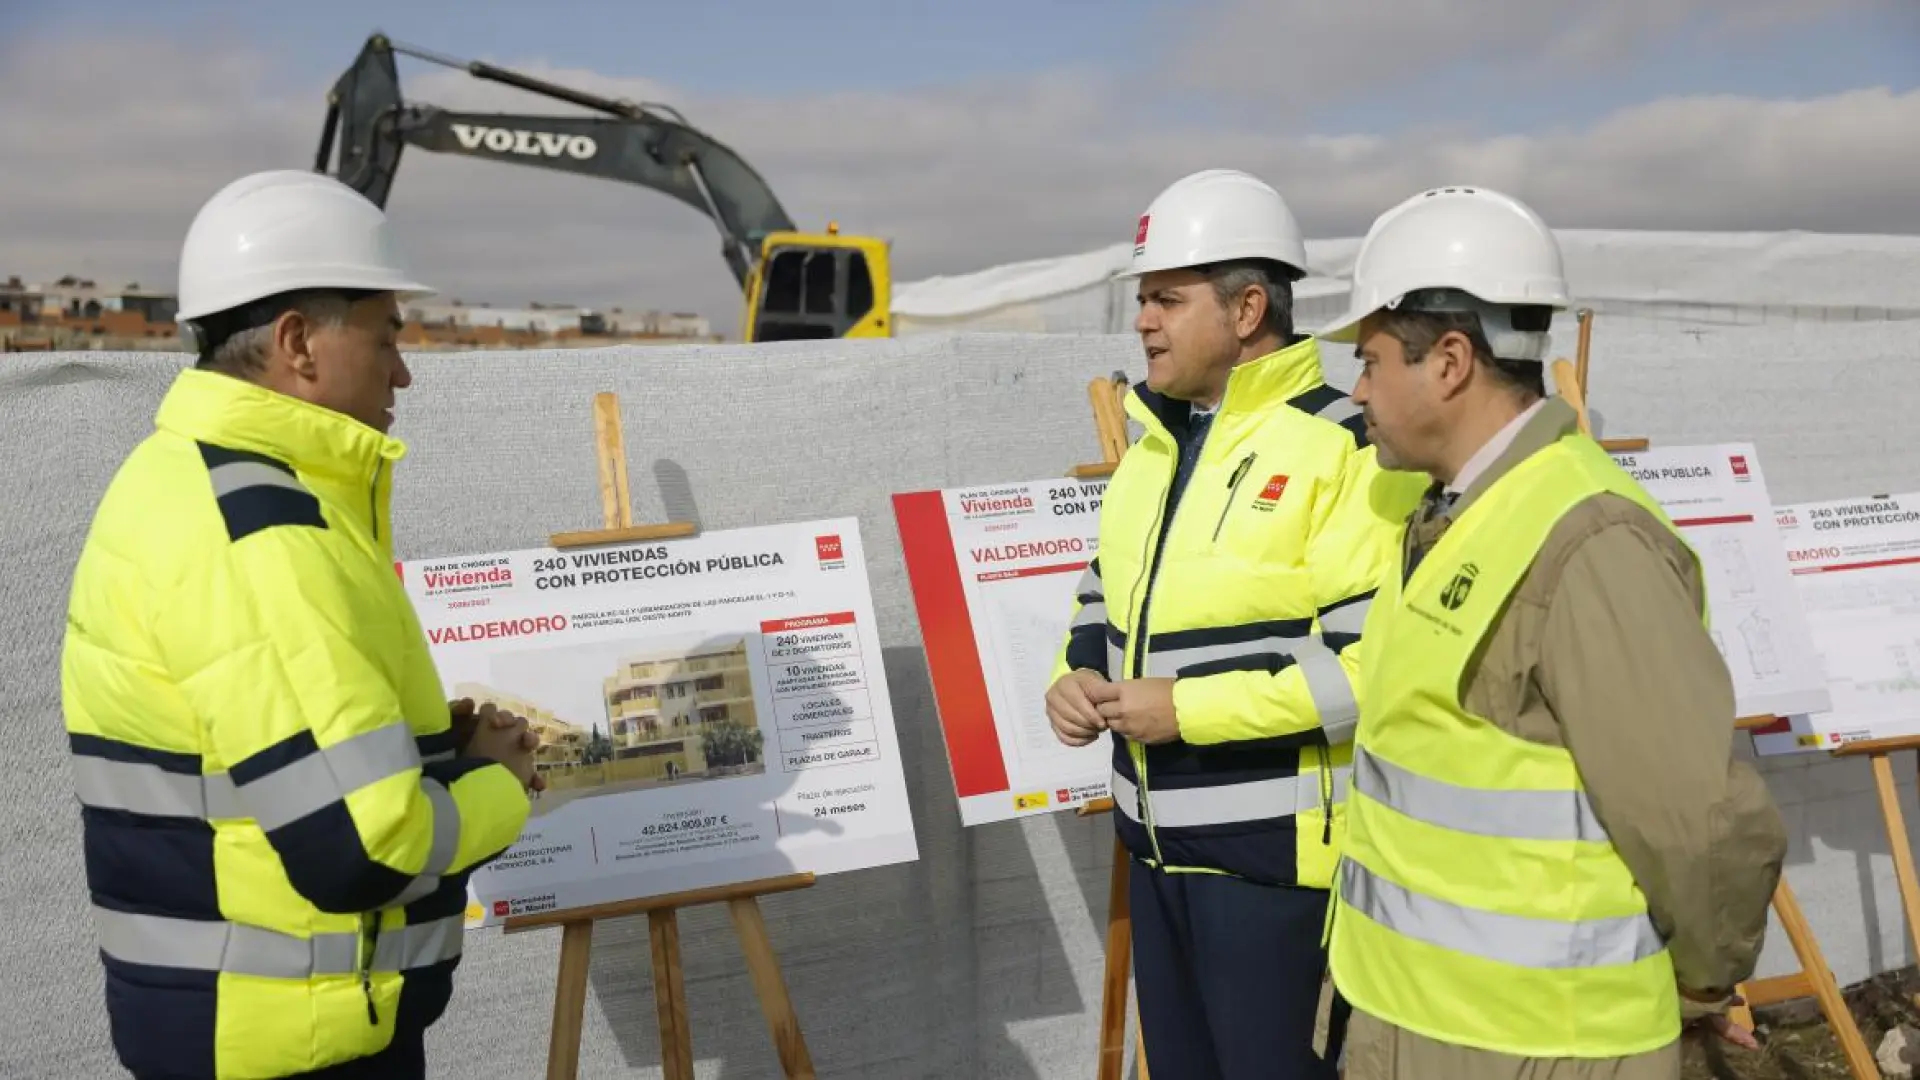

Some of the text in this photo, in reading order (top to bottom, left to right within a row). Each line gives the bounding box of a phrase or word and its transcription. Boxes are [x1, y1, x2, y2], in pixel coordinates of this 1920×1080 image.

[450, 123, 597, 160] VOLVO
[1049, 487, 1076, 500] 240
[961, 494, 1033, 514] Vivienda
[1053, 502, 1086, 516] CON
[1809, 508, 1832, 519] 240
[1834, 501, 1900, 516] VIVIENDAS
[1813, 520, 1841, 531] CON
[971, 537, 1083, 563] VALDEMORO
[423, 563, 446, 572] PLAN
[461, 559, 496, 569] CHOQUE
[499, 557, 510, 565] DE
[534, 546, 668, 572] 240 VIVIENDAS
[424, 567, 512, 589] Vivienda
[535, 552, 784, 590] CON PROTECCIÓN PÚBLICA
[428, 614, 567, 644] VALDEMORO
[784, 616, 829, 629] PROGRAMA
[776, 632, 844, 647] 240 VIVIENDAS
[771, 648, 784, 657] DE
[792, 641, 852, 655] DORMITORIOS
[785, 663, 846, 676] 10 VIVIENDAS
[801, 698, 841, 711] LOCALES
[792, 706, 854, 721] COMERCIALES
[801, 728, 852, 741] TRASTEROS
[789, 747, 871, 766] PLAZAS DE GARAJE
[814, 803, 867, 817] 24 meses
[720, 815, 728, 825] €
[510, 893, 556, 905] Comunidad
[511, 902, 556, 914] de Madrid
